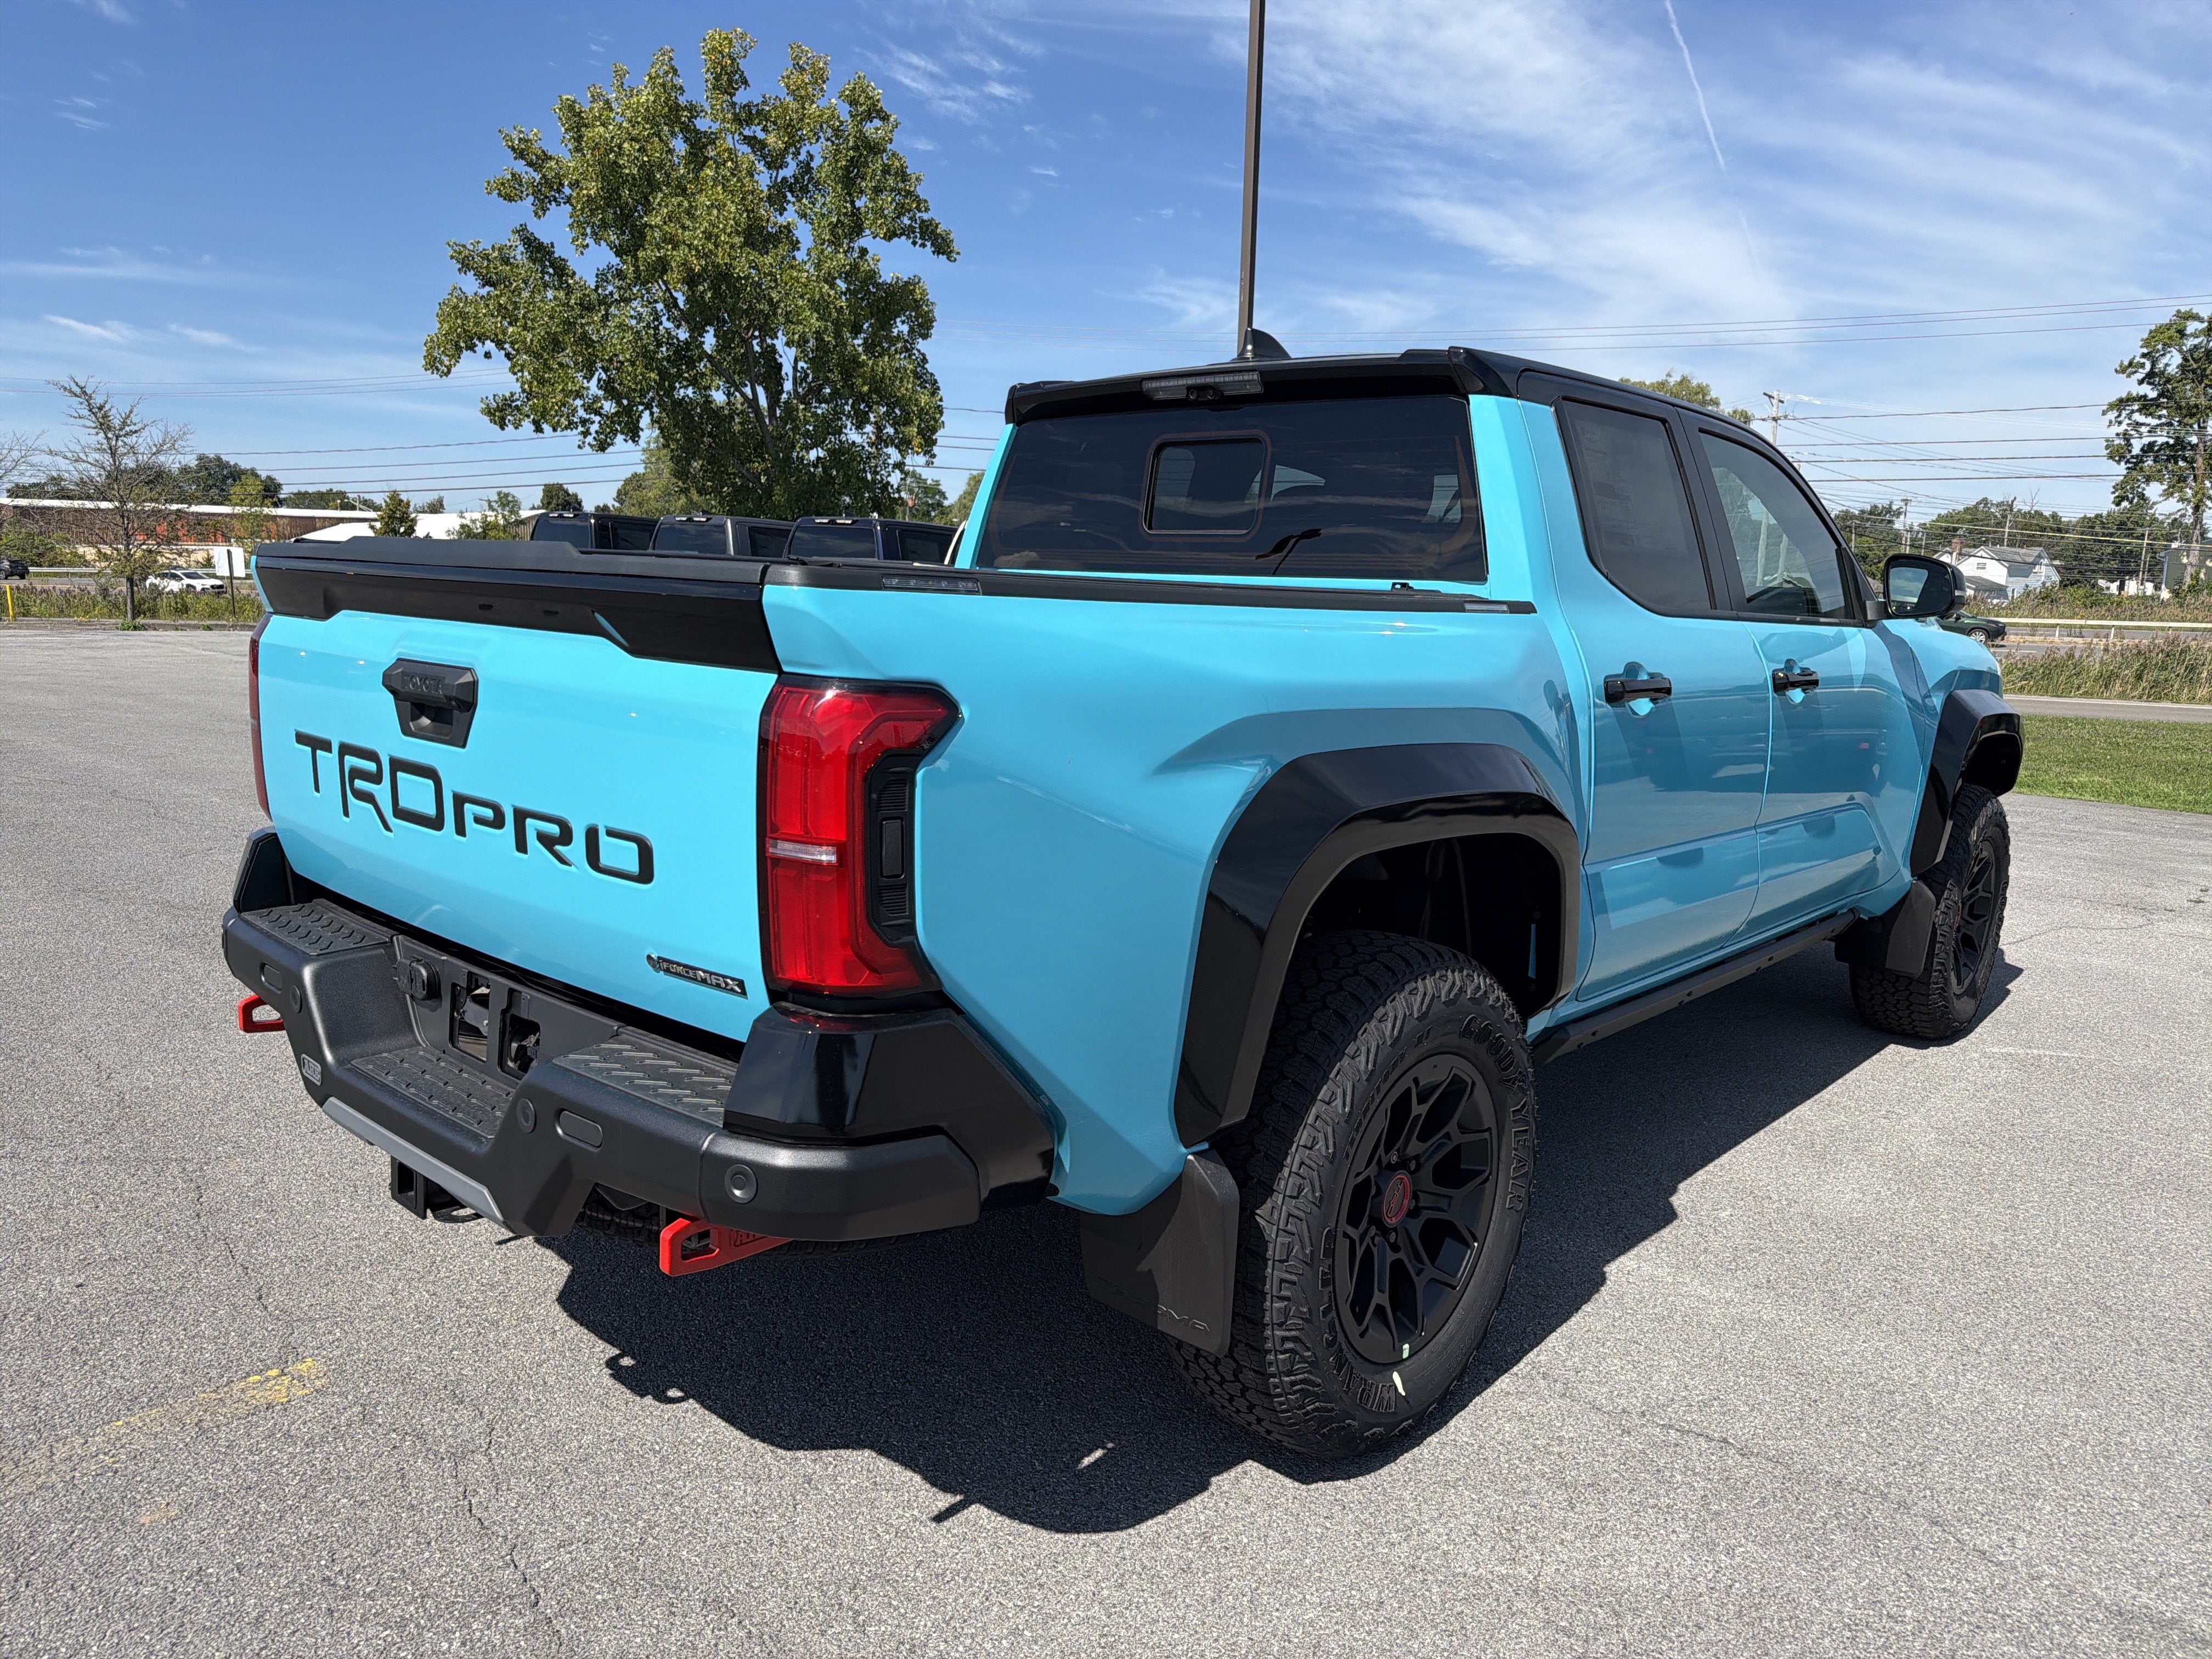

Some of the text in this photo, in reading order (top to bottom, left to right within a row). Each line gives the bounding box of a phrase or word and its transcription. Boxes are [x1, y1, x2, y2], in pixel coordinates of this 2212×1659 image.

[404, 674, 443, 695] TOYOTA
[452, 791, 655, 885] PRO
[1459, 1013, 1532, 1212] GOODYEAR
